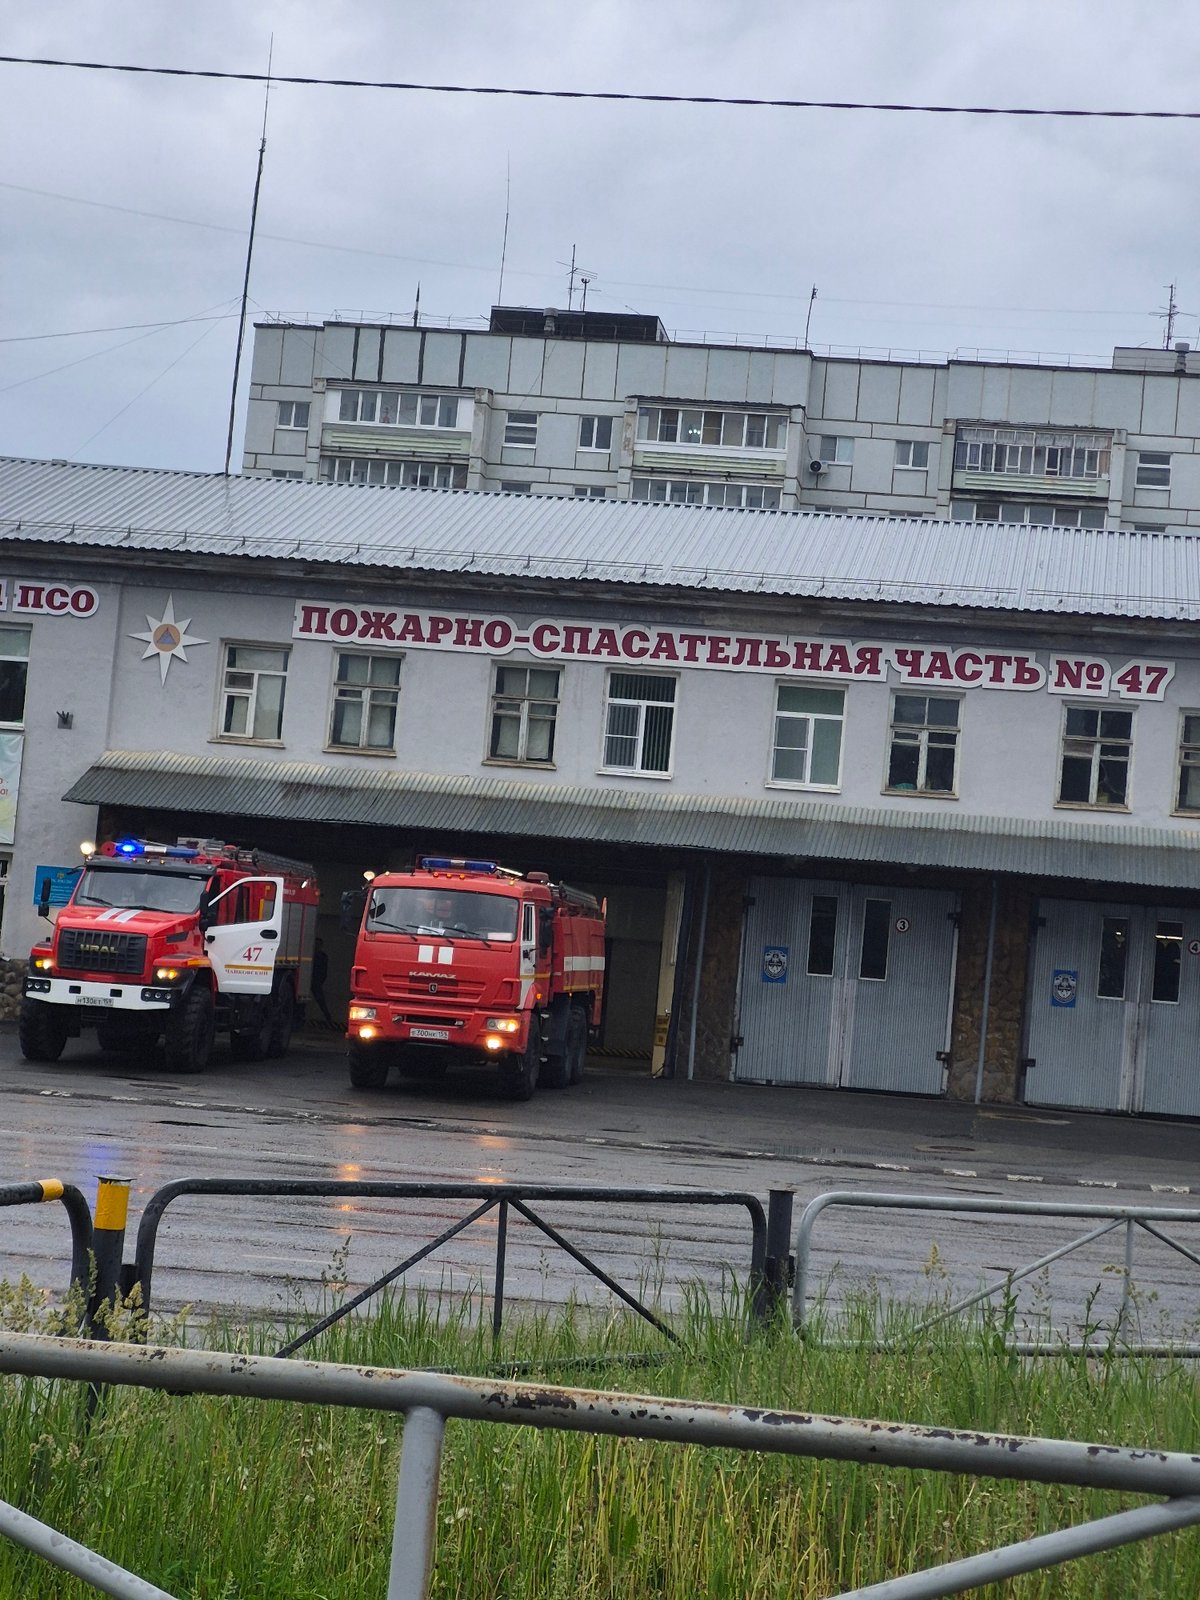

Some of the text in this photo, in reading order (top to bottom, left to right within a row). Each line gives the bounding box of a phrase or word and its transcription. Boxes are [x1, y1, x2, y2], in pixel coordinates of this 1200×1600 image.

[17, 585, 95, 613] ПСО
[299, 605, 883, 676] ПОЖАРНО-СПАСАТЕЛЬНАЯ
[895, 649, 1041, 686] ЧАСТЬ
[1117, 665, 1168, 695] 47
[899, 920, 906, 930] 3
[80, 943, 119, 954] URAL
[242, 947, 263, 962] 47
